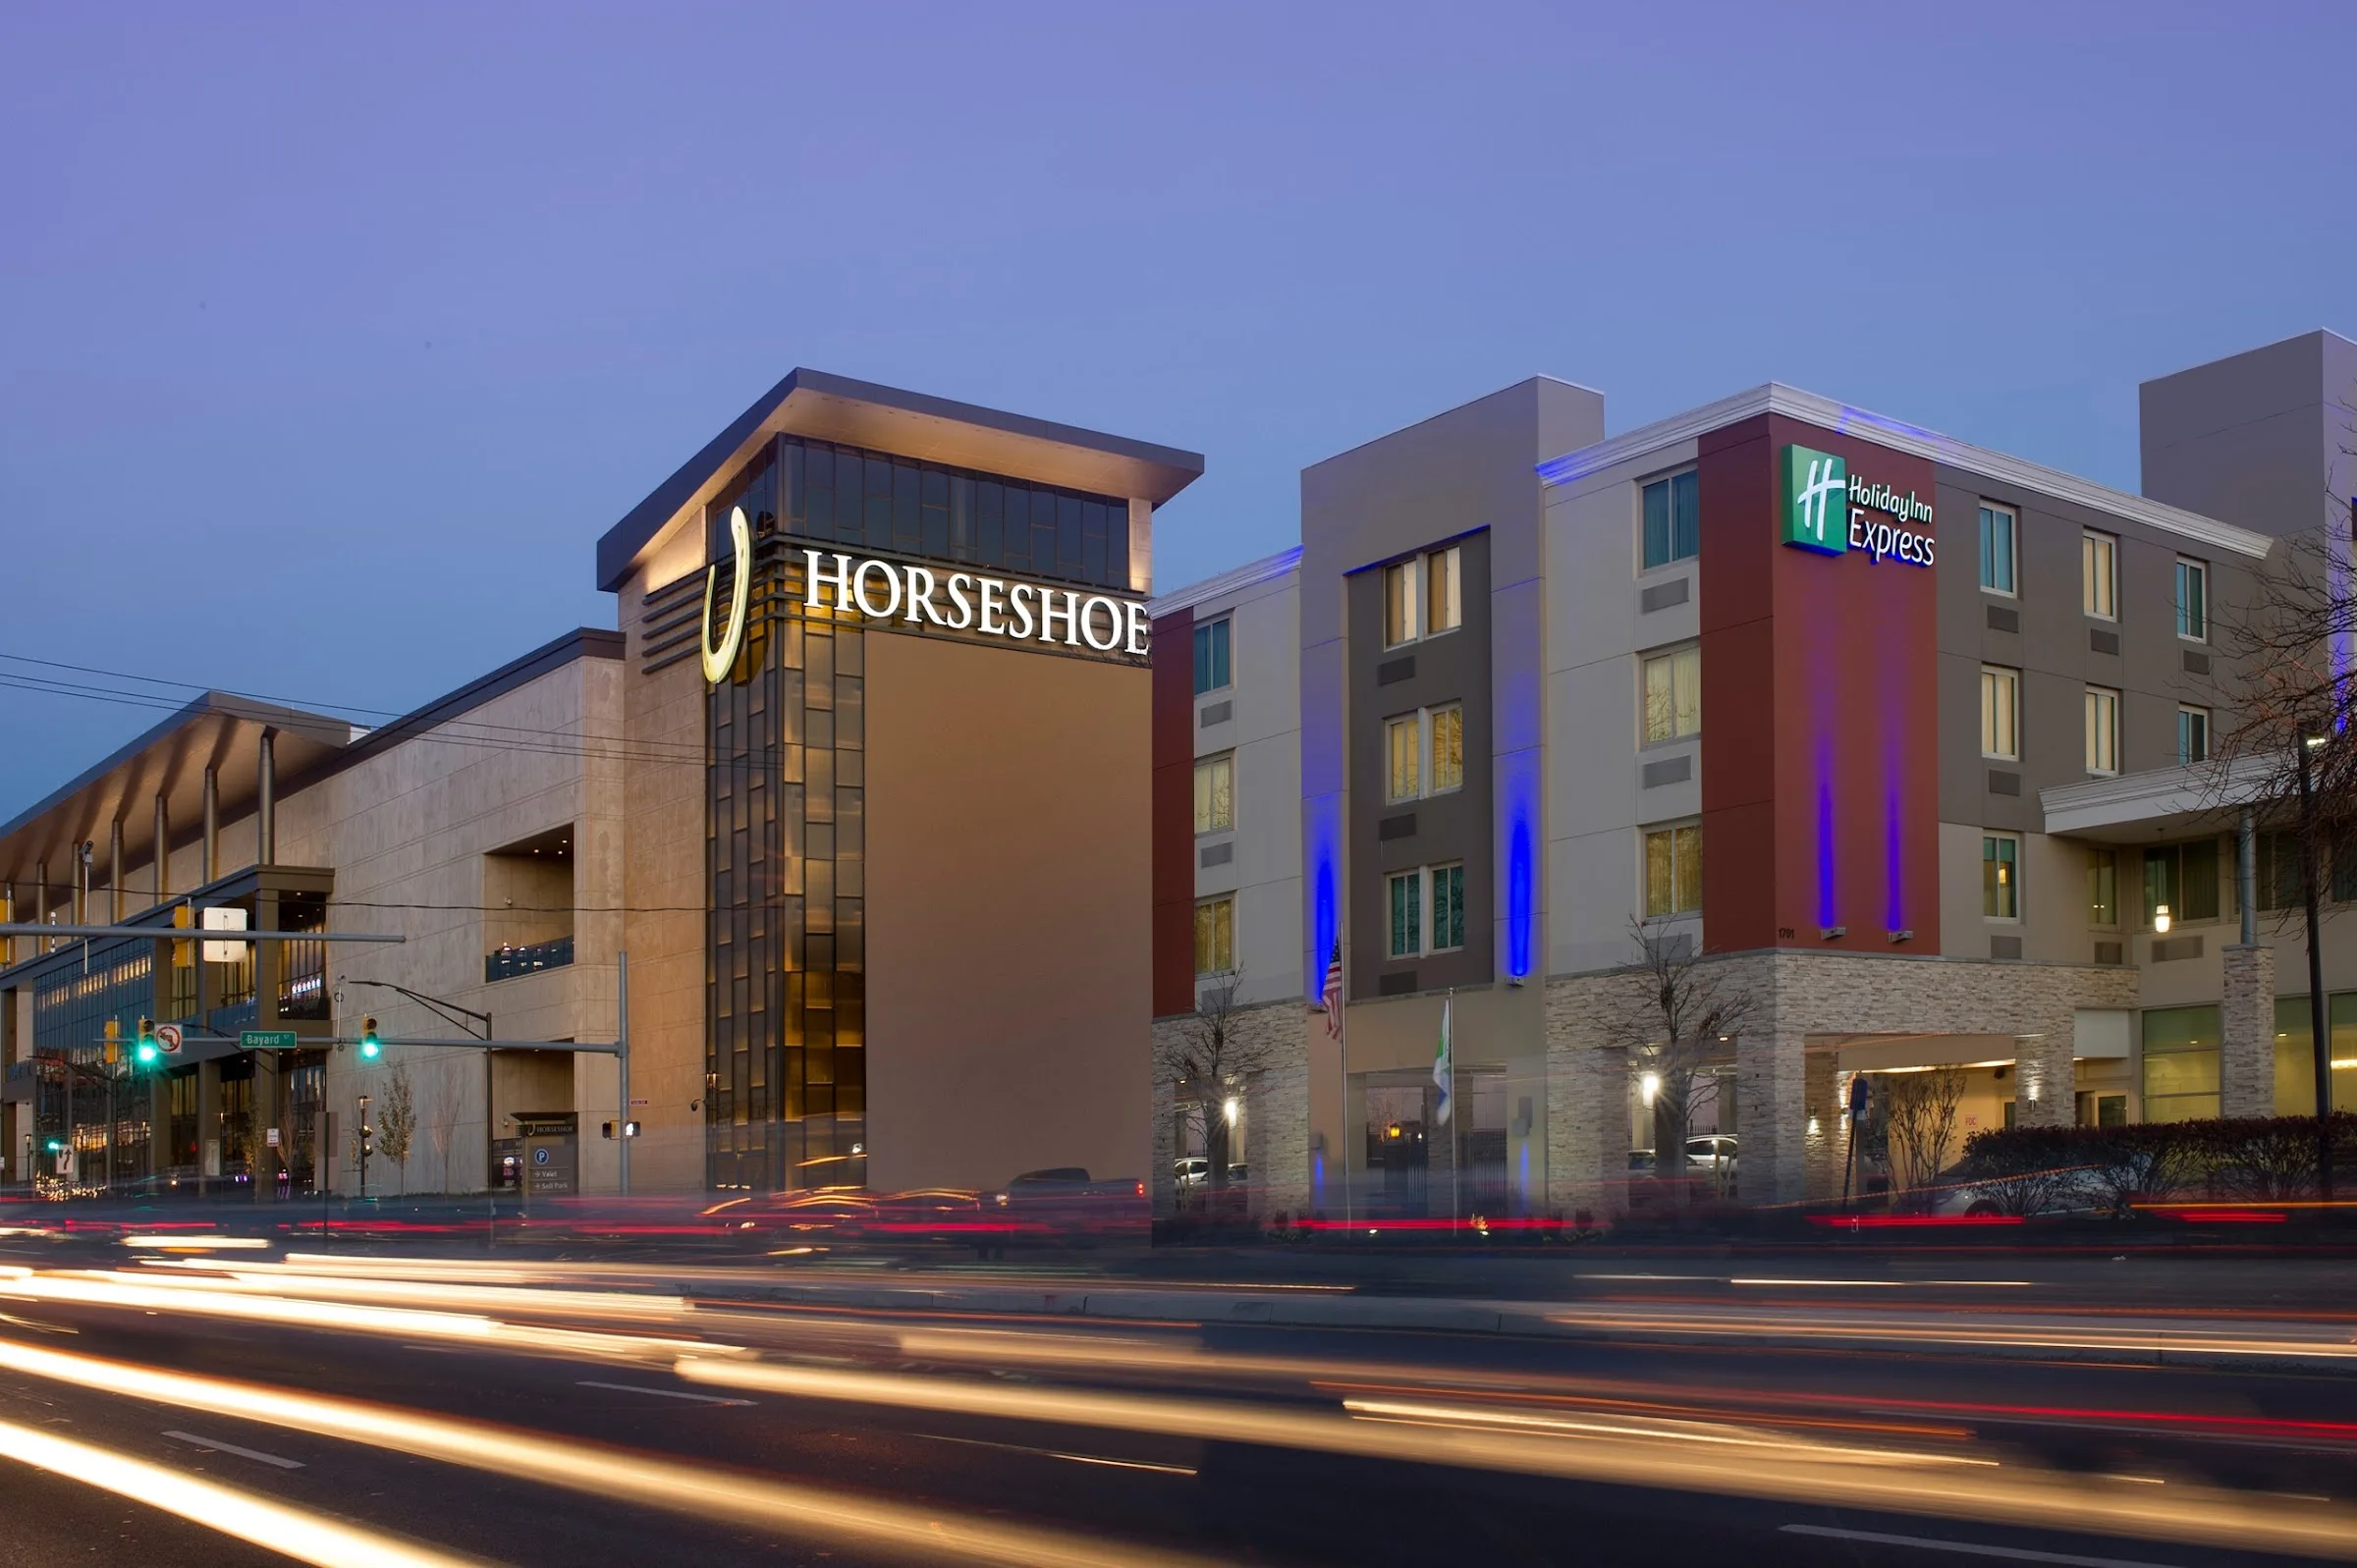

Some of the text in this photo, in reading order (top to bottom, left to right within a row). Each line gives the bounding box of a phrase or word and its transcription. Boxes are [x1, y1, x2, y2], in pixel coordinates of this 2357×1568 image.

[1849, 508, 1935, 566] Express
[802, 550, 1149, 655] HORSESHOE
[1779, 928, 1795, 939] 1701
[247, 1034, 280, 1048] Bayard
